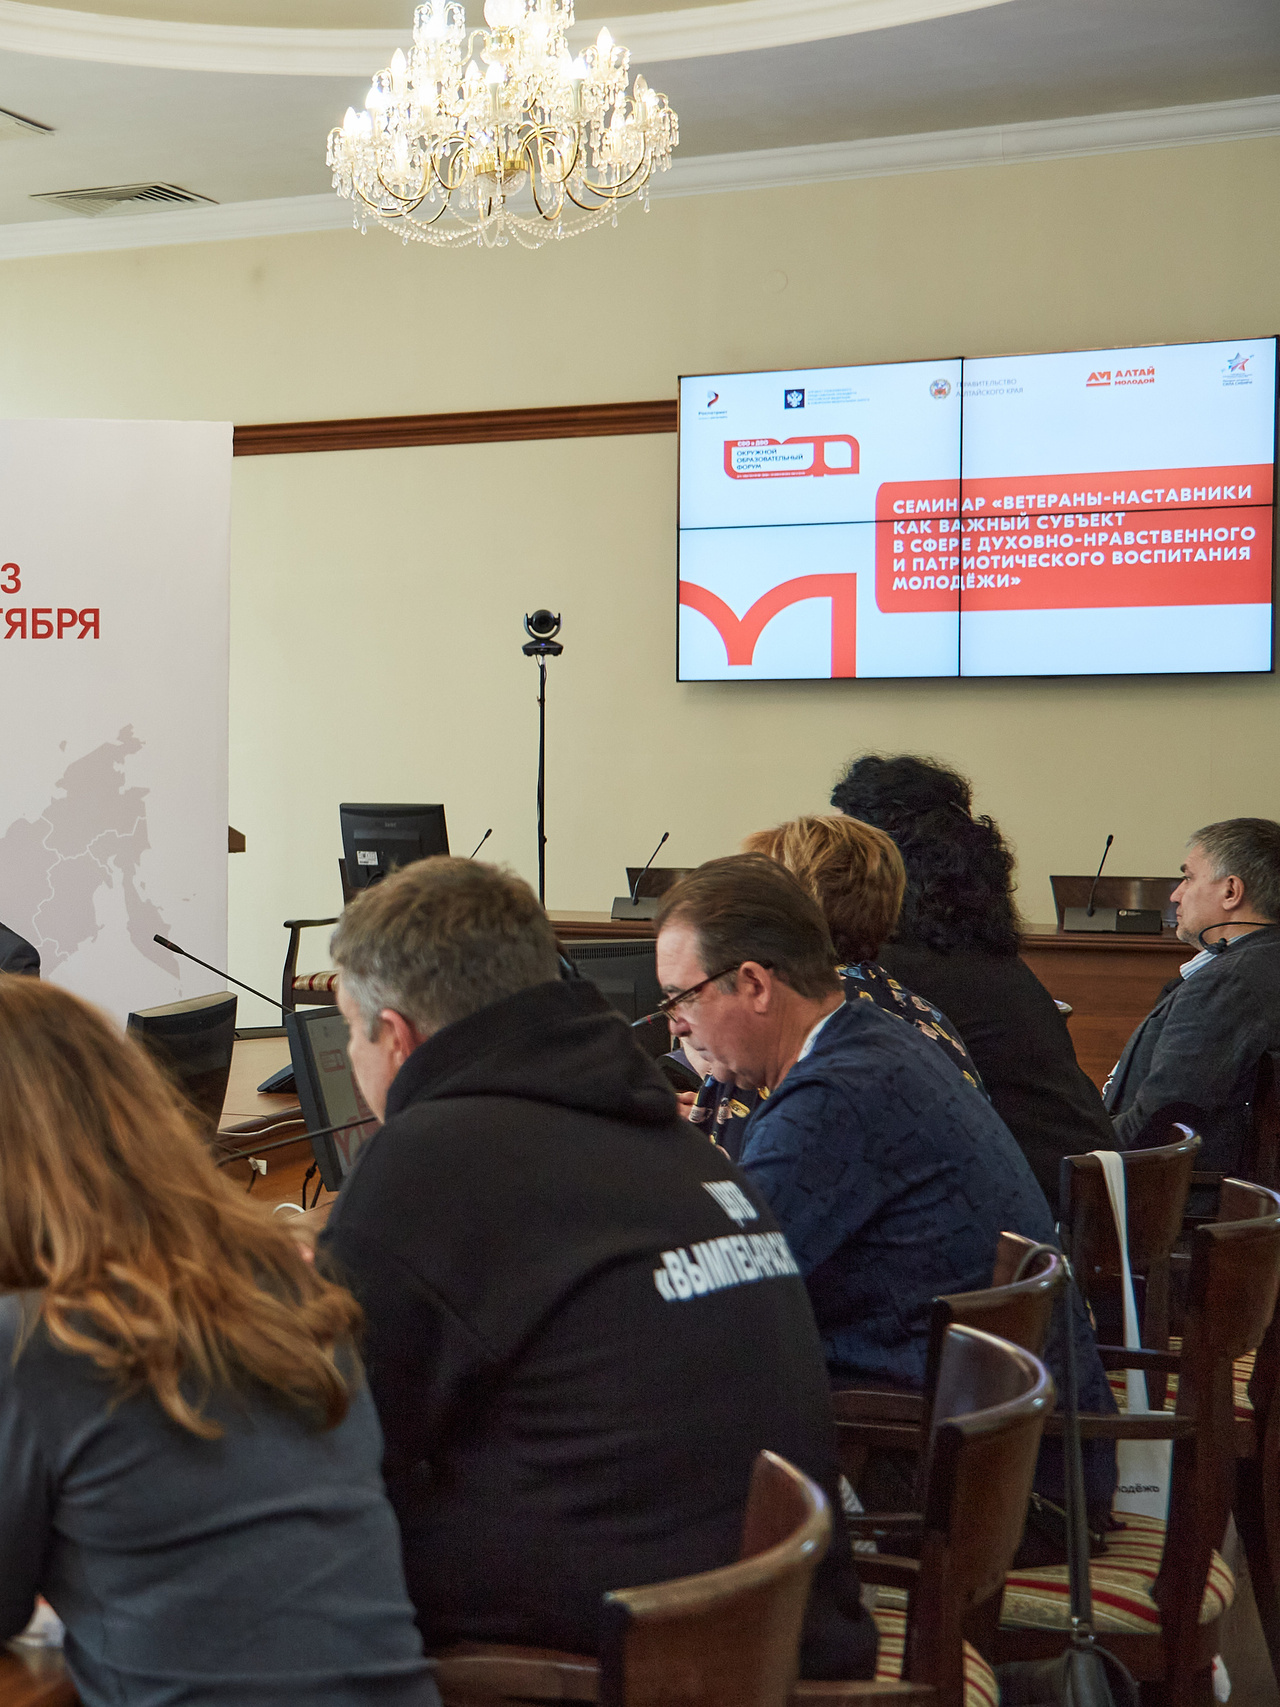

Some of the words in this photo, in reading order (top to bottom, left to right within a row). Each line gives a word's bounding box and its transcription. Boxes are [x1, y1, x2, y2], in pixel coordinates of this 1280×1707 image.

[1115, 366, 1155, 378] АЛТАЙ
[736, 454, 804, 463] ОБРАЗОВАТЕЛЬНЫЙ
[737, 448, 777, 457] ОКРУЖНОЙ
[893, 497, 986, 514] СЕМИНАР
[992, 485, 1252, 510] «ВЕТЕРАНЫ-НАСТАВНИКИ
[893, 519, 932, 535] КАК
[939, 511, 1030, 533] ВАЖНЫЙ
[1036, 512, 1126, 530] СУБЪЕКТ
[893, 540, 904, 554] В
[910, 538, 971, 553] СФЕРЕ
[977, 526, 1256, 553] ДУХОВНО-НРАВСТВЕННОГО
[893, 558, 906, 572] И
[912, 551, 1105, 572] ПАТРИОТИЧЕСКОГО
[1112, 546, 1251, 565] ВОСПИТАНИЯ
[892, 573, 1022, 591] МОЛОДЁЖИ»
